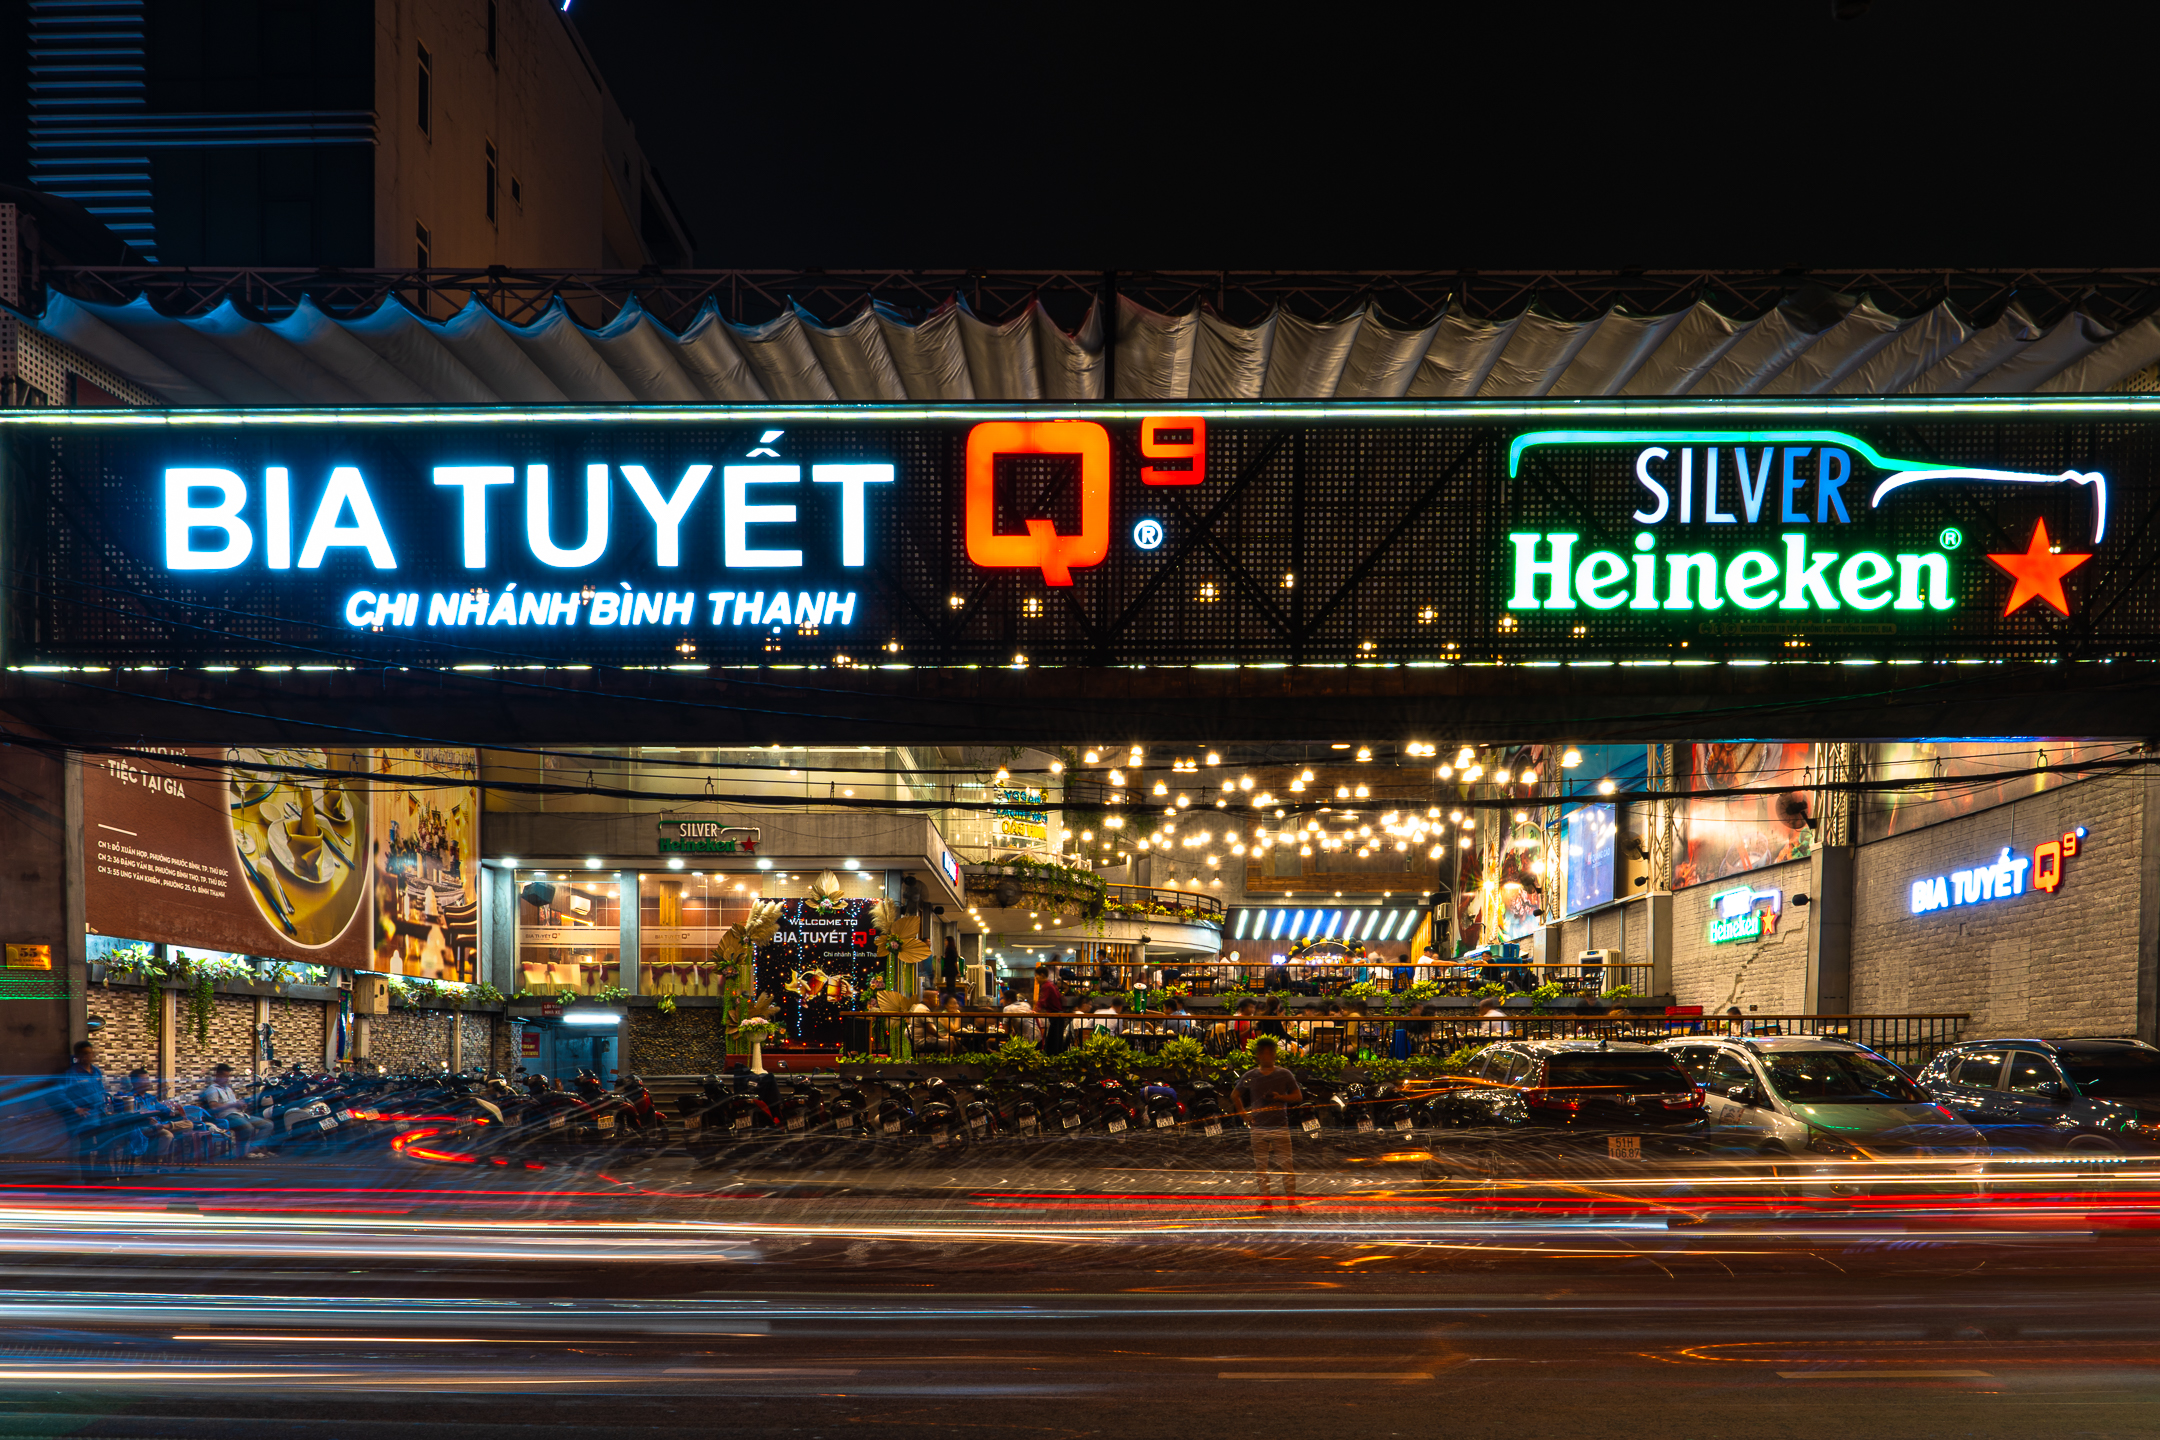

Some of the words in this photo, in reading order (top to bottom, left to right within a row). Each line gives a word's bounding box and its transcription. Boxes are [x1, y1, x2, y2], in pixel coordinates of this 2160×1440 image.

[1632, 446, 1852, 525] SILVER
[164, 466, 398, 571] BIA
[432, 430, 896, 569] TUYẾT
[1506, 531, 1956, 612] Heineken
[345, 589, 416, 628] CHI
[426, 582, 586, 628] NHÁNH
[588, 580, 694, 628] BÌNH
[708, 590, 858, 635] THẠNH
[108, 759, 137, 785] TIỆC
[164, 778, 185, 798] GIA
[680, 823, 718, 837] SILVER
[98, 840, 107, 848] CN
[121, 845, 136, 855] XUÂN
[149, 852, 171, 864] PHƯỜNG
[659, 837, 736, 852] Heineken
[98, 852, 107, 861] CN
[98, 865, 107, 874] CN
[112, 868, 120, 877] 55
[1911, 876, 1949, 914] BIA
[1951, 847, 2029, 905] TUYẾT
[789, 918, 842, 926] WELCOME
[1709, 915, 1761, 943] Heineken
[773, 931, 798, 943] BIA
[20, 947, 38, 958] 55
[1616, 1137, 1633, 1147] 51H
